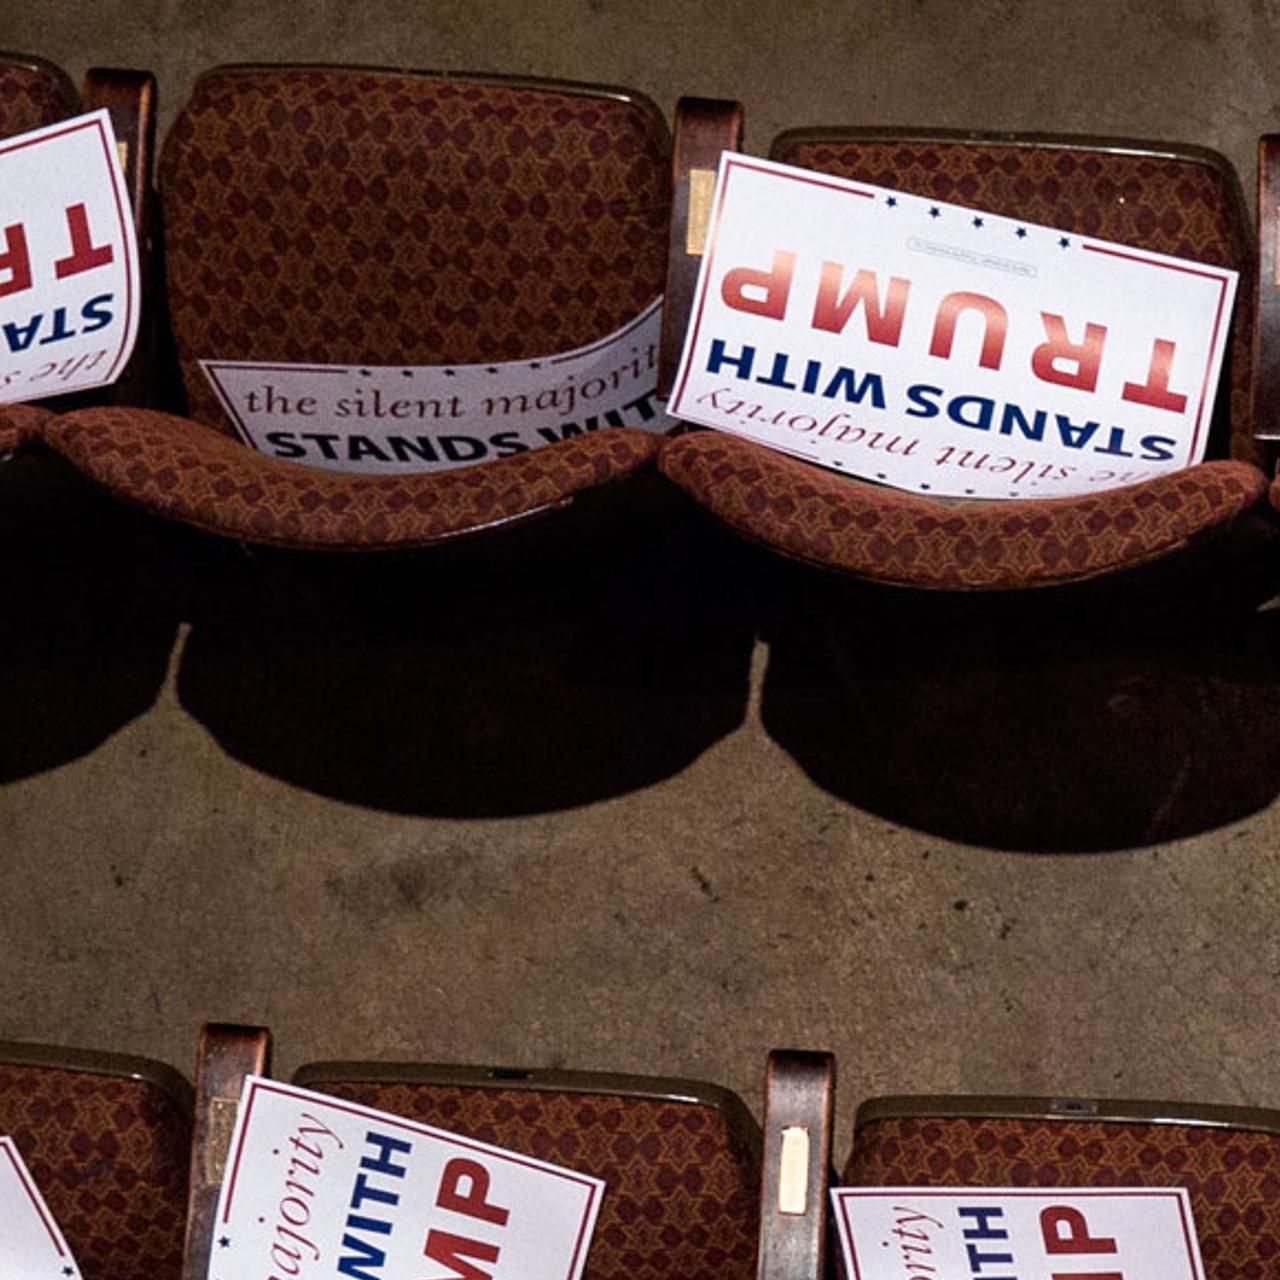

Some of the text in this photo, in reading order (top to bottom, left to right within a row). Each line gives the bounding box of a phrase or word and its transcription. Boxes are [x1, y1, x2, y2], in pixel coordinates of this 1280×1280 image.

[246, 344, 656, 418] the silent majorit
[721, 249, 1188, 414] TRUMP
[266, 432, 530, 462] STANDS
[696, 388, 1068, 488] silent majority
[706, 338, 1177, 463] STANDS WITH
